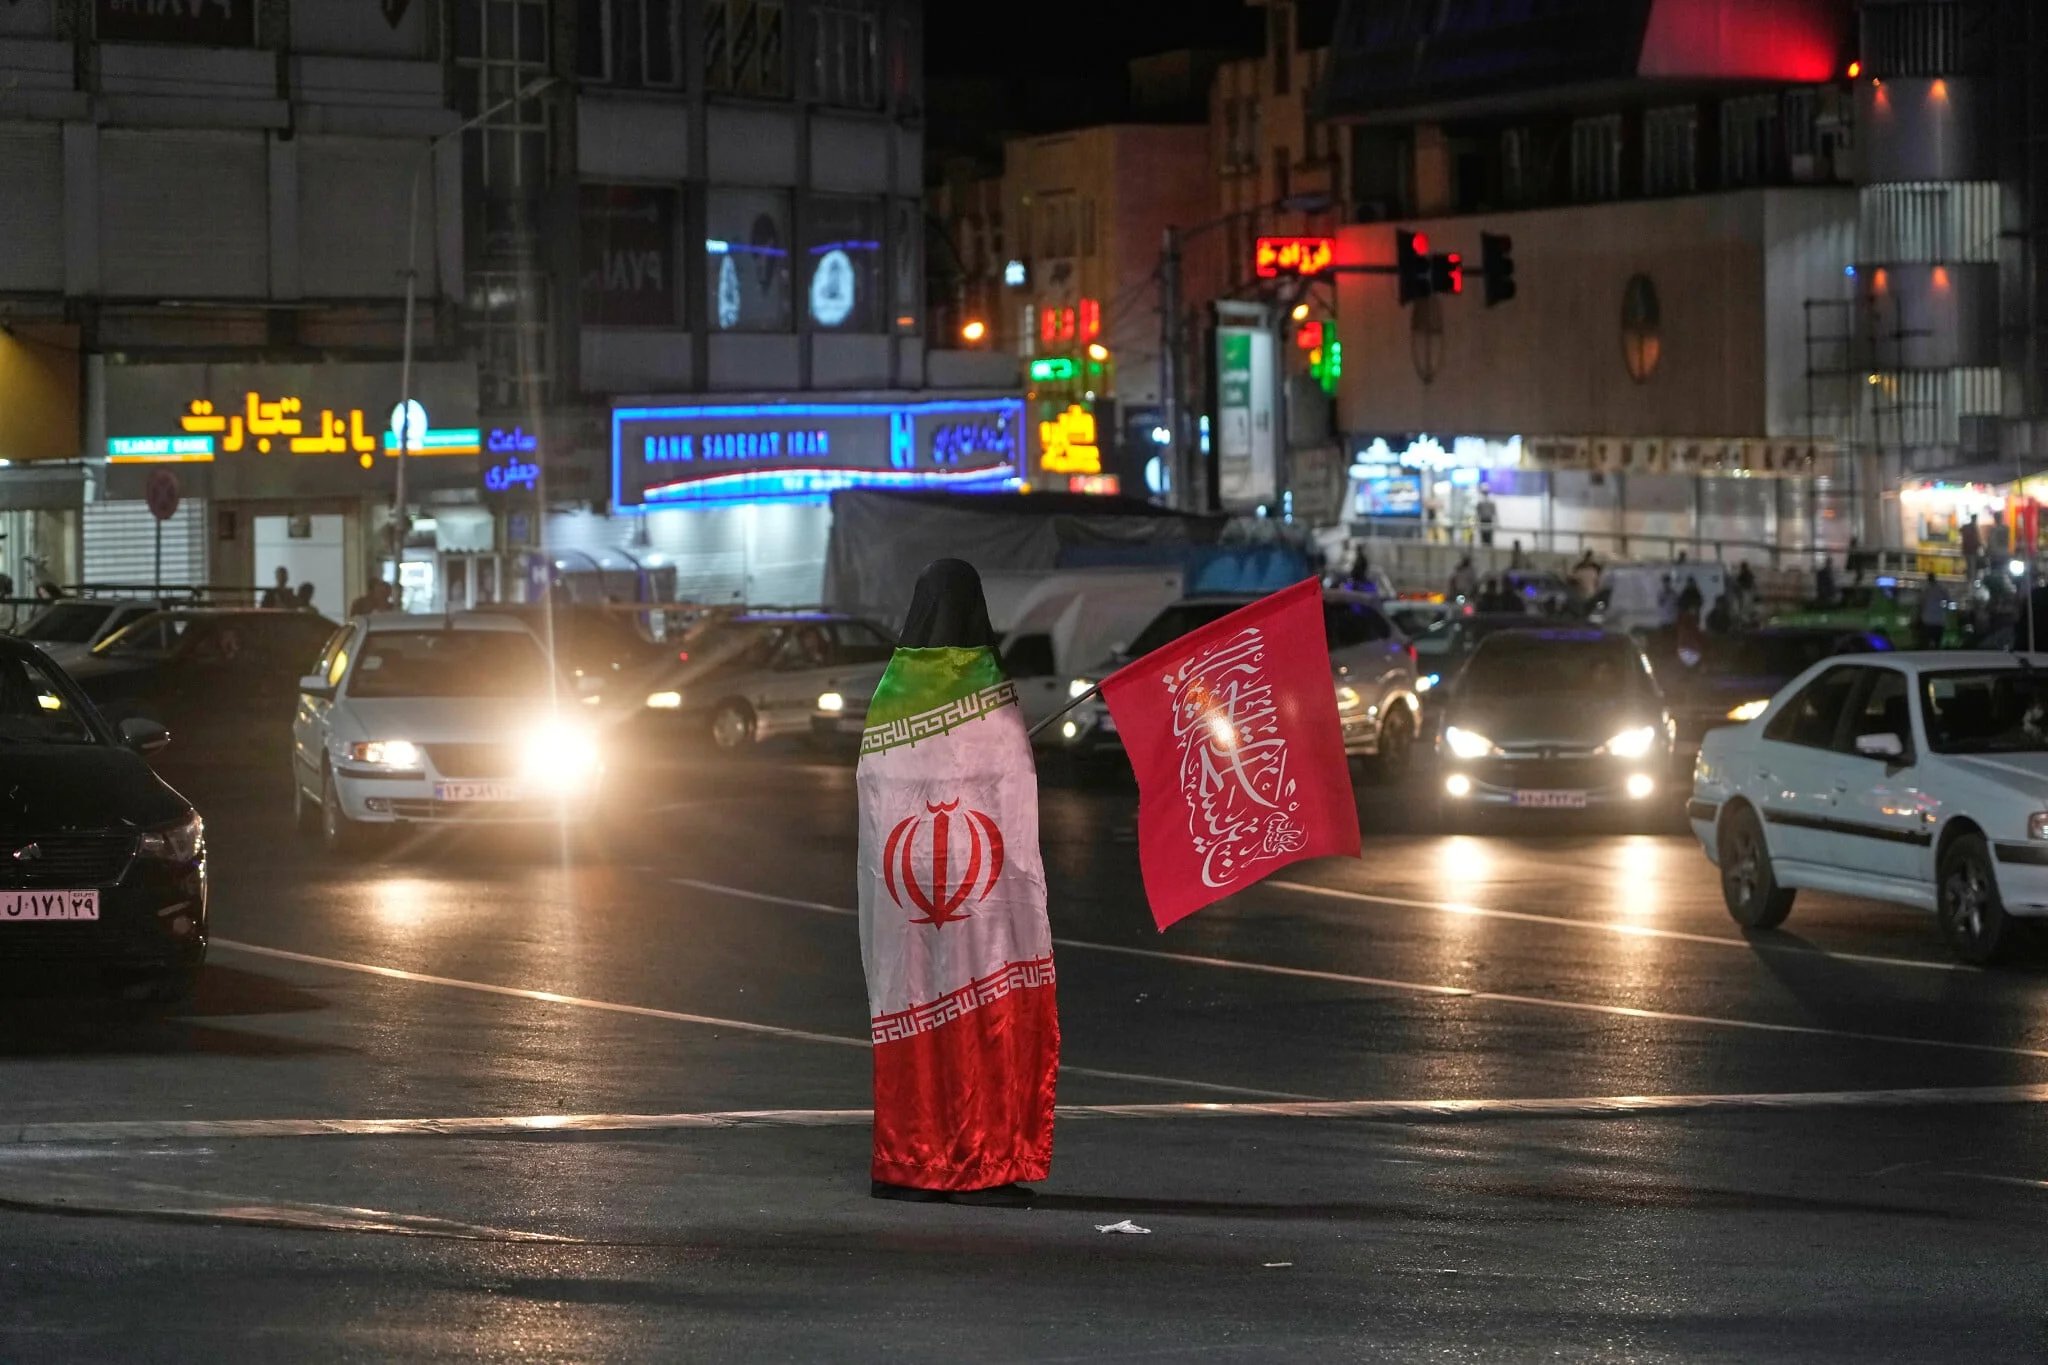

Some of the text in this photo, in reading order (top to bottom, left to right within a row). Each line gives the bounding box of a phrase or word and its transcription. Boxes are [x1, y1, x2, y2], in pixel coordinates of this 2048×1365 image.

[181, 391, 376, 469] بانک تجارت
[488, 427, 537, 452] ساعت
[645, 430, 829, 462] BANK SADERAT IRAN
[485, 456, 540, 490] جعفری
[72, 898, 96, 917] ۲۹
